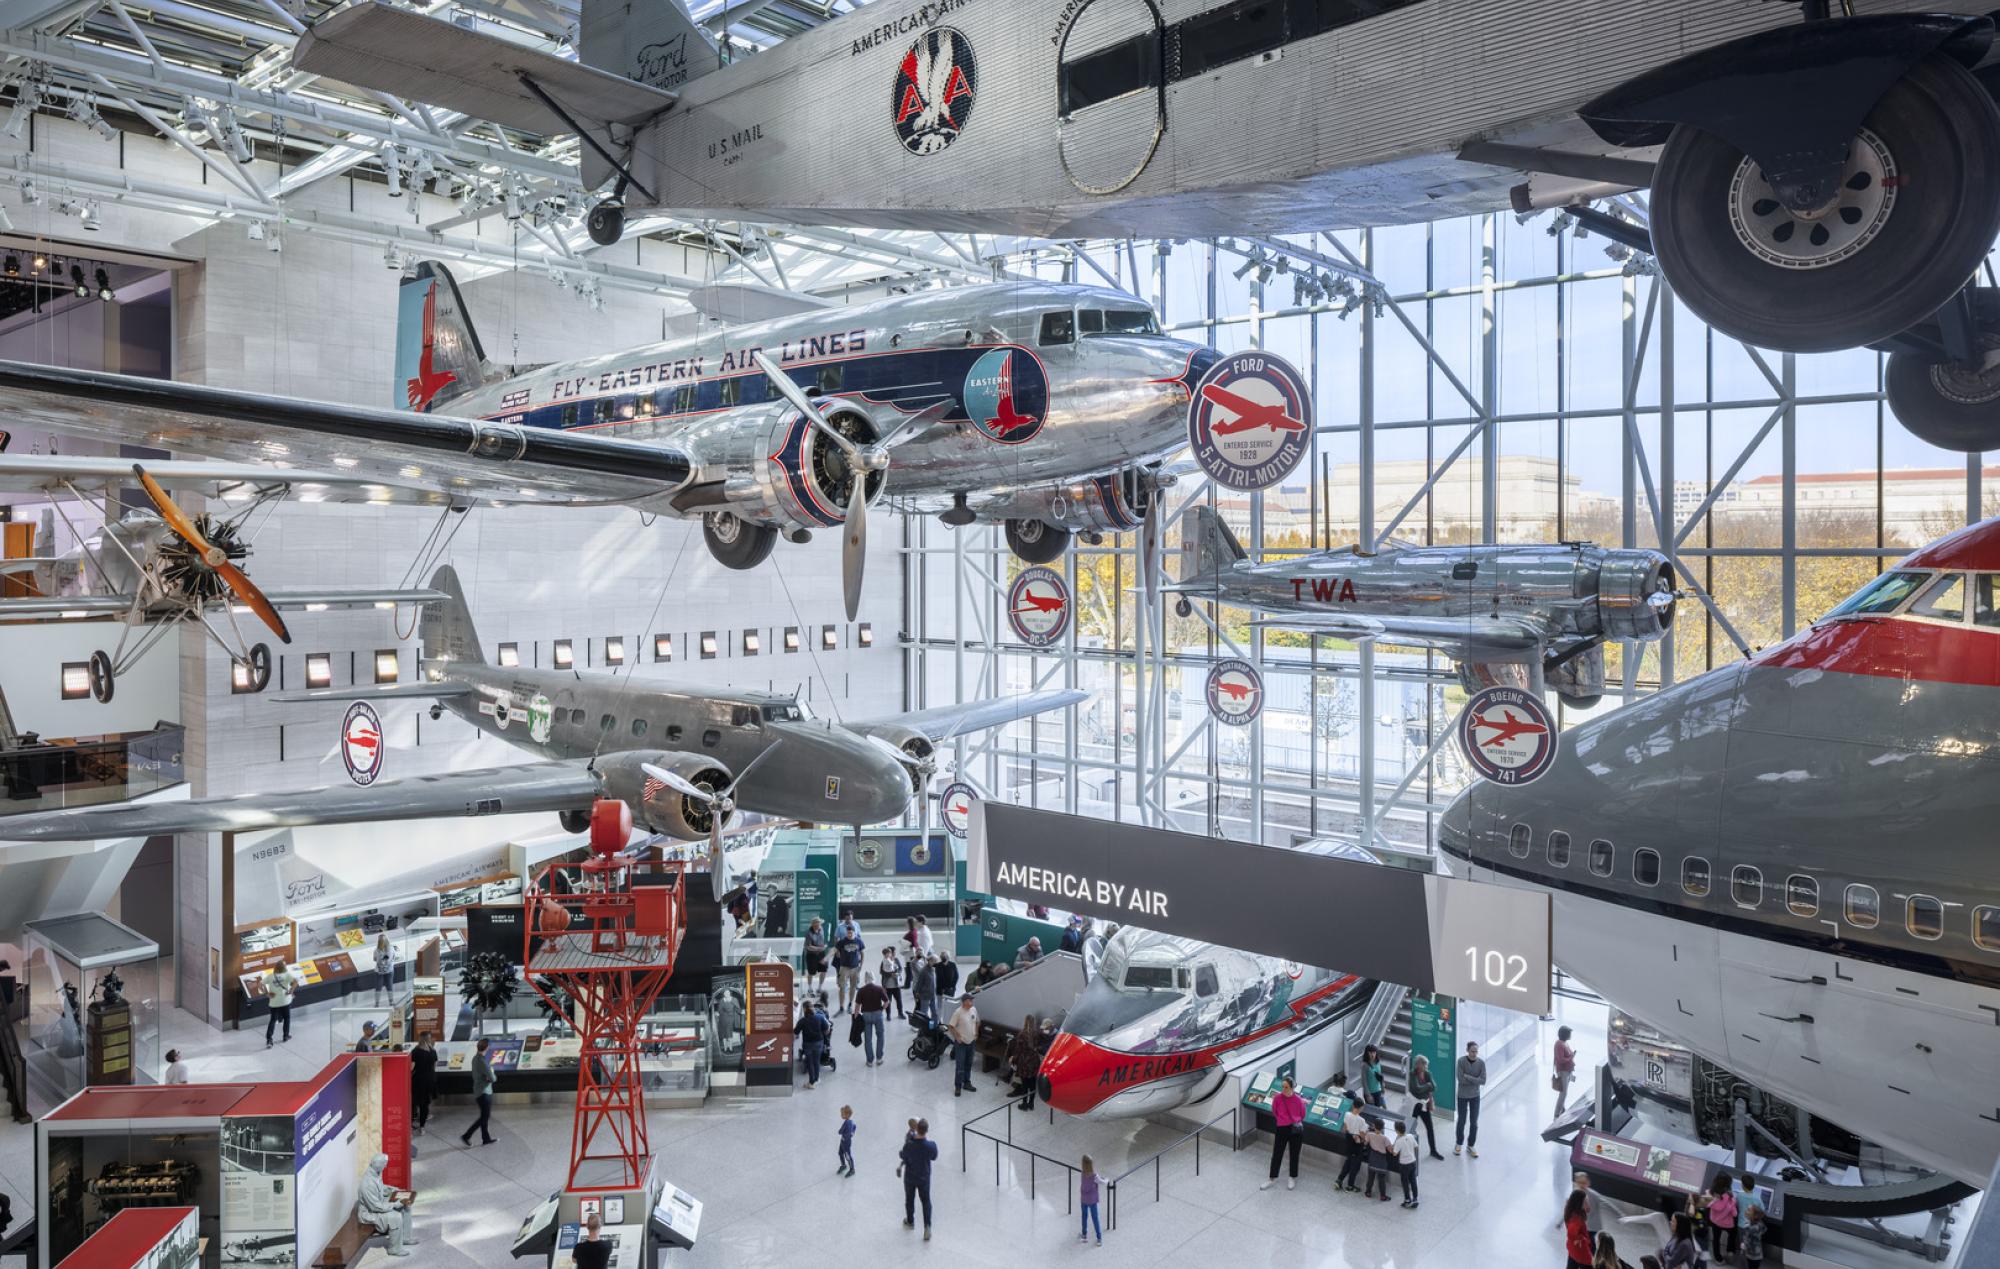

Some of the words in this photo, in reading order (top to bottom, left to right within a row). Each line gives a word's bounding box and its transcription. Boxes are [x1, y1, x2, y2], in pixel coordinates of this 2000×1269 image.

[632, 32, 688, 82] Ford
[731, 124, 764, 147] MAIL
[553, 377, 583, 398] FLY
[598, 358, 703, 391] EASTERN
[782, 328, 865, 361] LINES
[1233, 358, 1265, 375] FORD
[970, 377, 1009, 387] EASTERN
[1223, 440, 1248, 449] ENTERED
[1249, 439, 1273, 449] SERVICE
[1239, 450, 1257, 460] 1928
[1200, 446, 1229, 477] 5-AT
[1228, 443, 1300, 487] TRI-MOTOR
[1288, 578, 1357, 603] TWA
[1490, 691, 1524, 705] BOEING
[1497, 769, 1515, 782] 747
[252, 844, 286, 861] N9683
[285, 874, 326, 899] Ford
[996, 861, 1093, 902] AMERICA
[1096, 880, 1126, 907] BY
[1128, 888, 1169, 917] AIR
[1465, 946, 1528, 993] 102
[1098, 1053, 1197, 1087] AMERICAN
